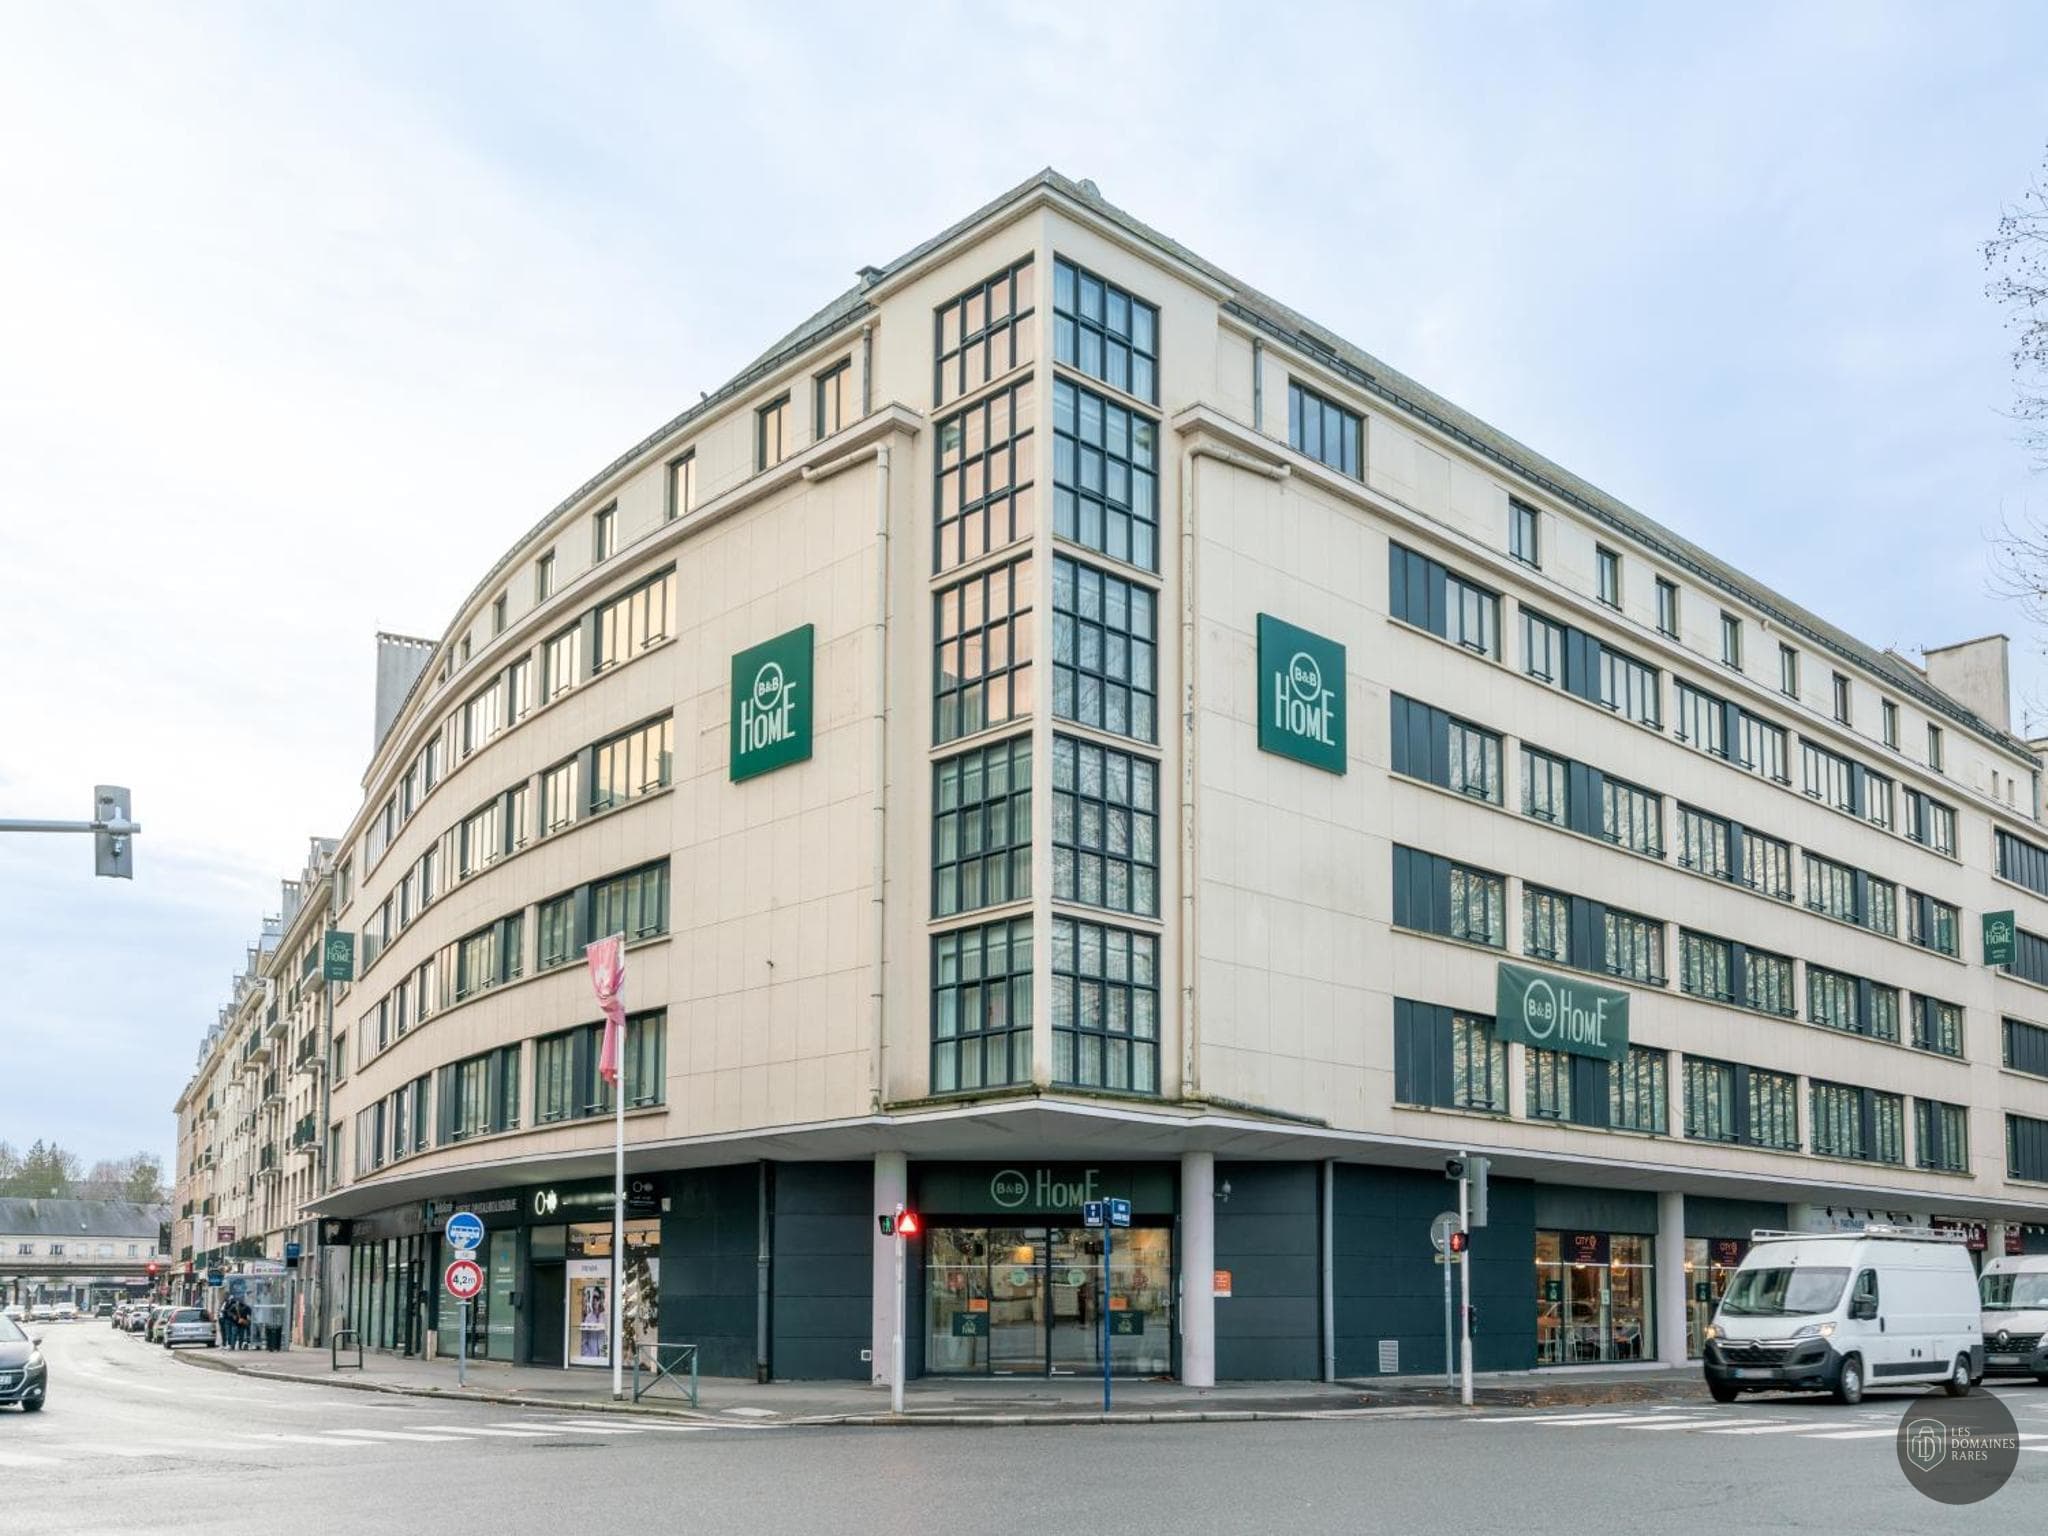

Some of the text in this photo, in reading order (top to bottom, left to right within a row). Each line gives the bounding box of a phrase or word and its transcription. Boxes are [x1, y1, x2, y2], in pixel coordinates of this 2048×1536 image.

[757, 676, 780, 697] B&B
[1295, 666, 1317, 687] B&B
[740, 682, 797, 755] HOME
[1275, 671, 1335, 746] HOME
[1528, 998, 1552, 1020] B&B
[453, 1274, 476, 1286] 4,2m
